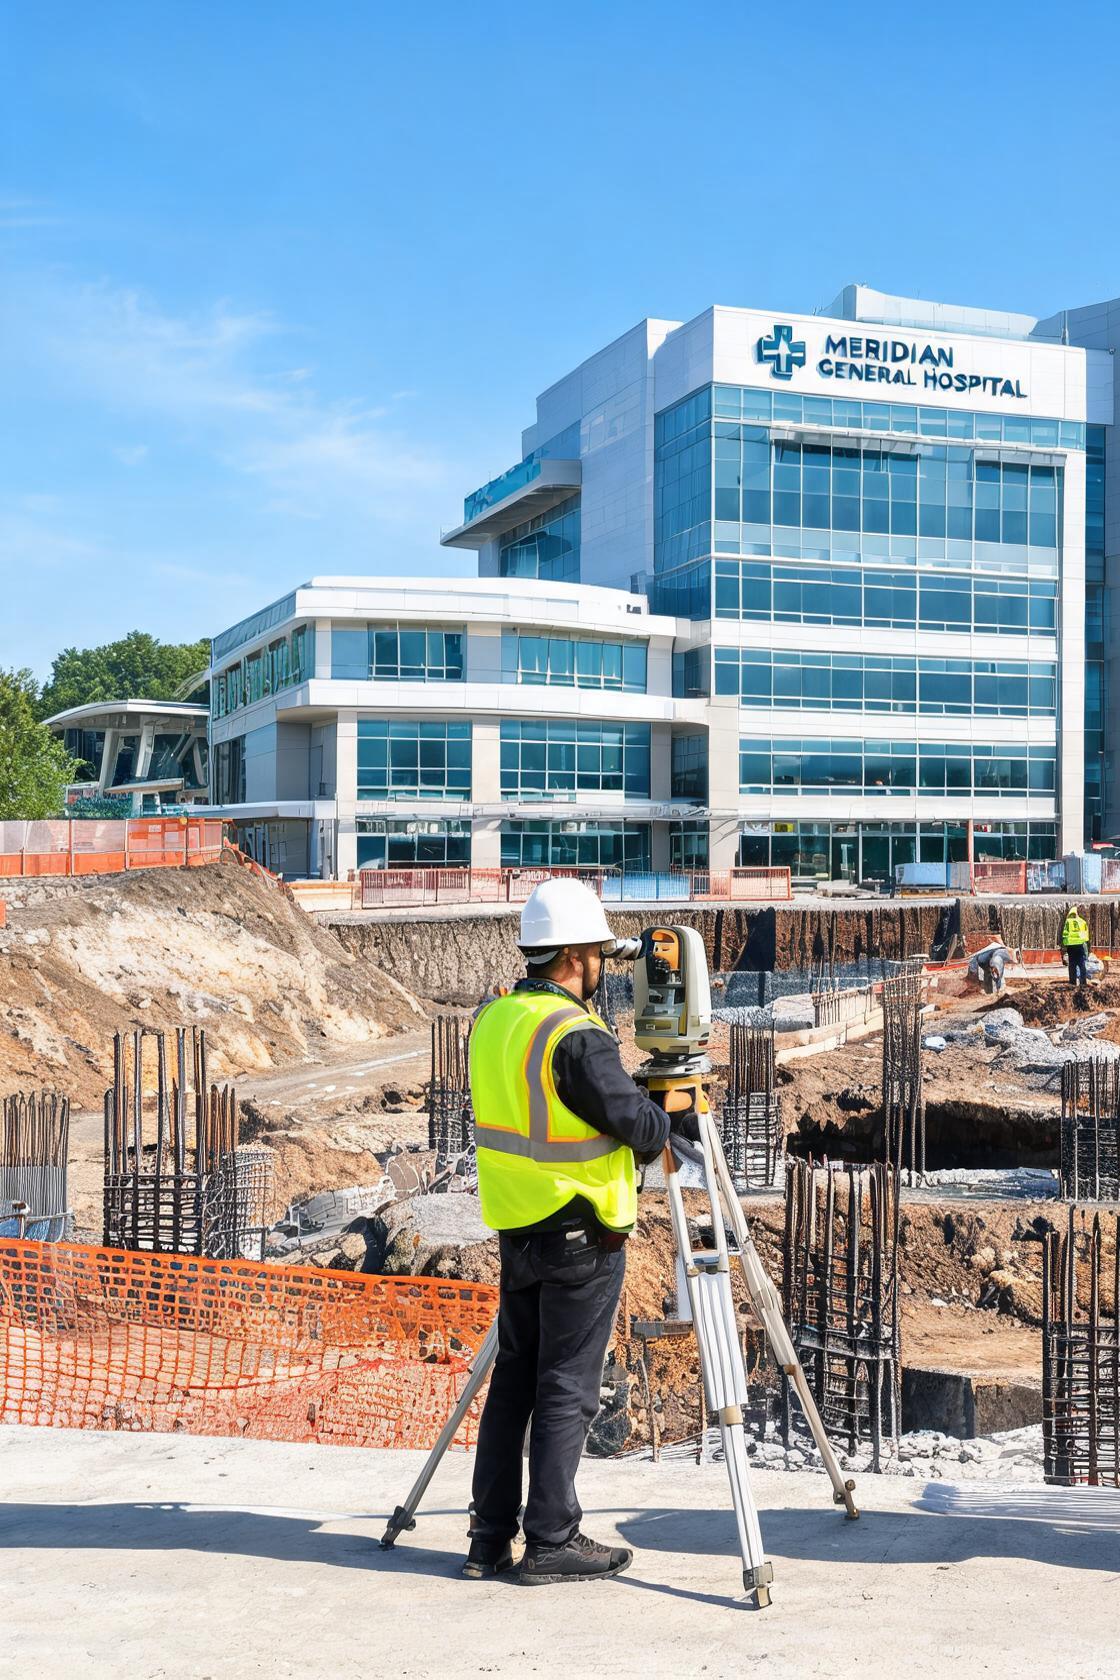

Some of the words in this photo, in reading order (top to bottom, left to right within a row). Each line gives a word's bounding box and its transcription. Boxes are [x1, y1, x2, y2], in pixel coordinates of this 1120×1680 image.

[825, 334, 954, 368] MERIDIAN
[817, 358, 917, 386] GENERAL
[923, 367, 1028, 399] HOSPITAL
